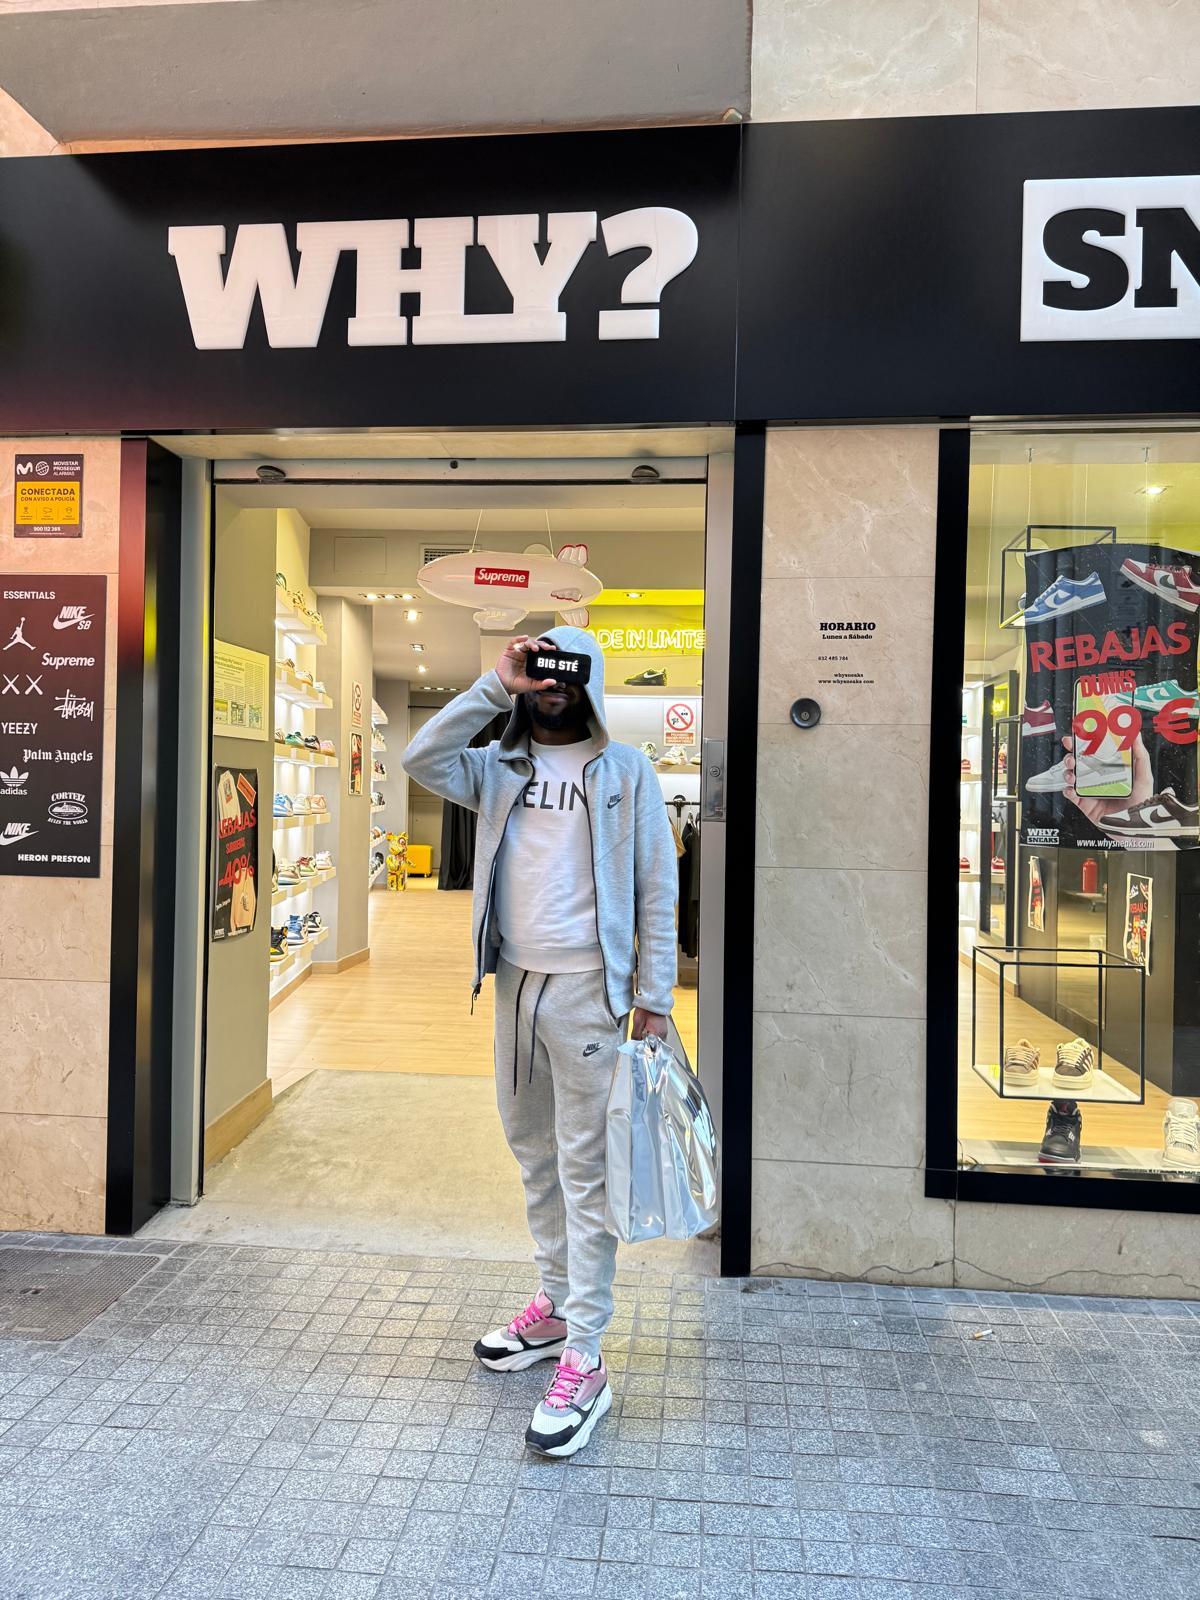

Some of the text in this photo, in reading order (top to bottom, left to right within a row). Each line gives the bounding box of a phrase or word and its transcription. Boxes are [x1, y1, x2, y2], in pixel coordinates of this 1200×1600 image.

[1042, 207, 1200, 312] SN
[168, 206, 699, 350] WHY?
[21, 488, 75, 496] CONECTADA
[477, 568, 526, 585] Supreme
[3, 590, 56, 600] ESSENTIALS
[59, 606, 87, 619] NIKE
[77, 620, 92, 630] SB
[819, 622, 876, 631] HORARIO
[626, 629, 645, 649] IN
[1030, 622, 1191, 673] REBAJAS
[41, 652, 96, 670] Supreme
[537, 657, 579, 672] BIG STÉ
[1079, 669, 1137, 698] DUNKS
[1, 722, 39, 735] YEEZY
[1072, 697, 1198, 756] 99 €
[23, 749, 94, 764] Palm Angels
[0, 787, 28, 796] adidas
[4, 822, 32, 836] NIKE
[1027, 827, 1060, 837] WHY?
[1028, 836, 1059, 844] SNEAKS
[1076, 838, 1155, 849] www.whysneaks.com
[18, 853, 91, 864] HERON PRESTON
[218, 850, 255, 888] -40%
[585, 1042, 600, 1052] NIKE
